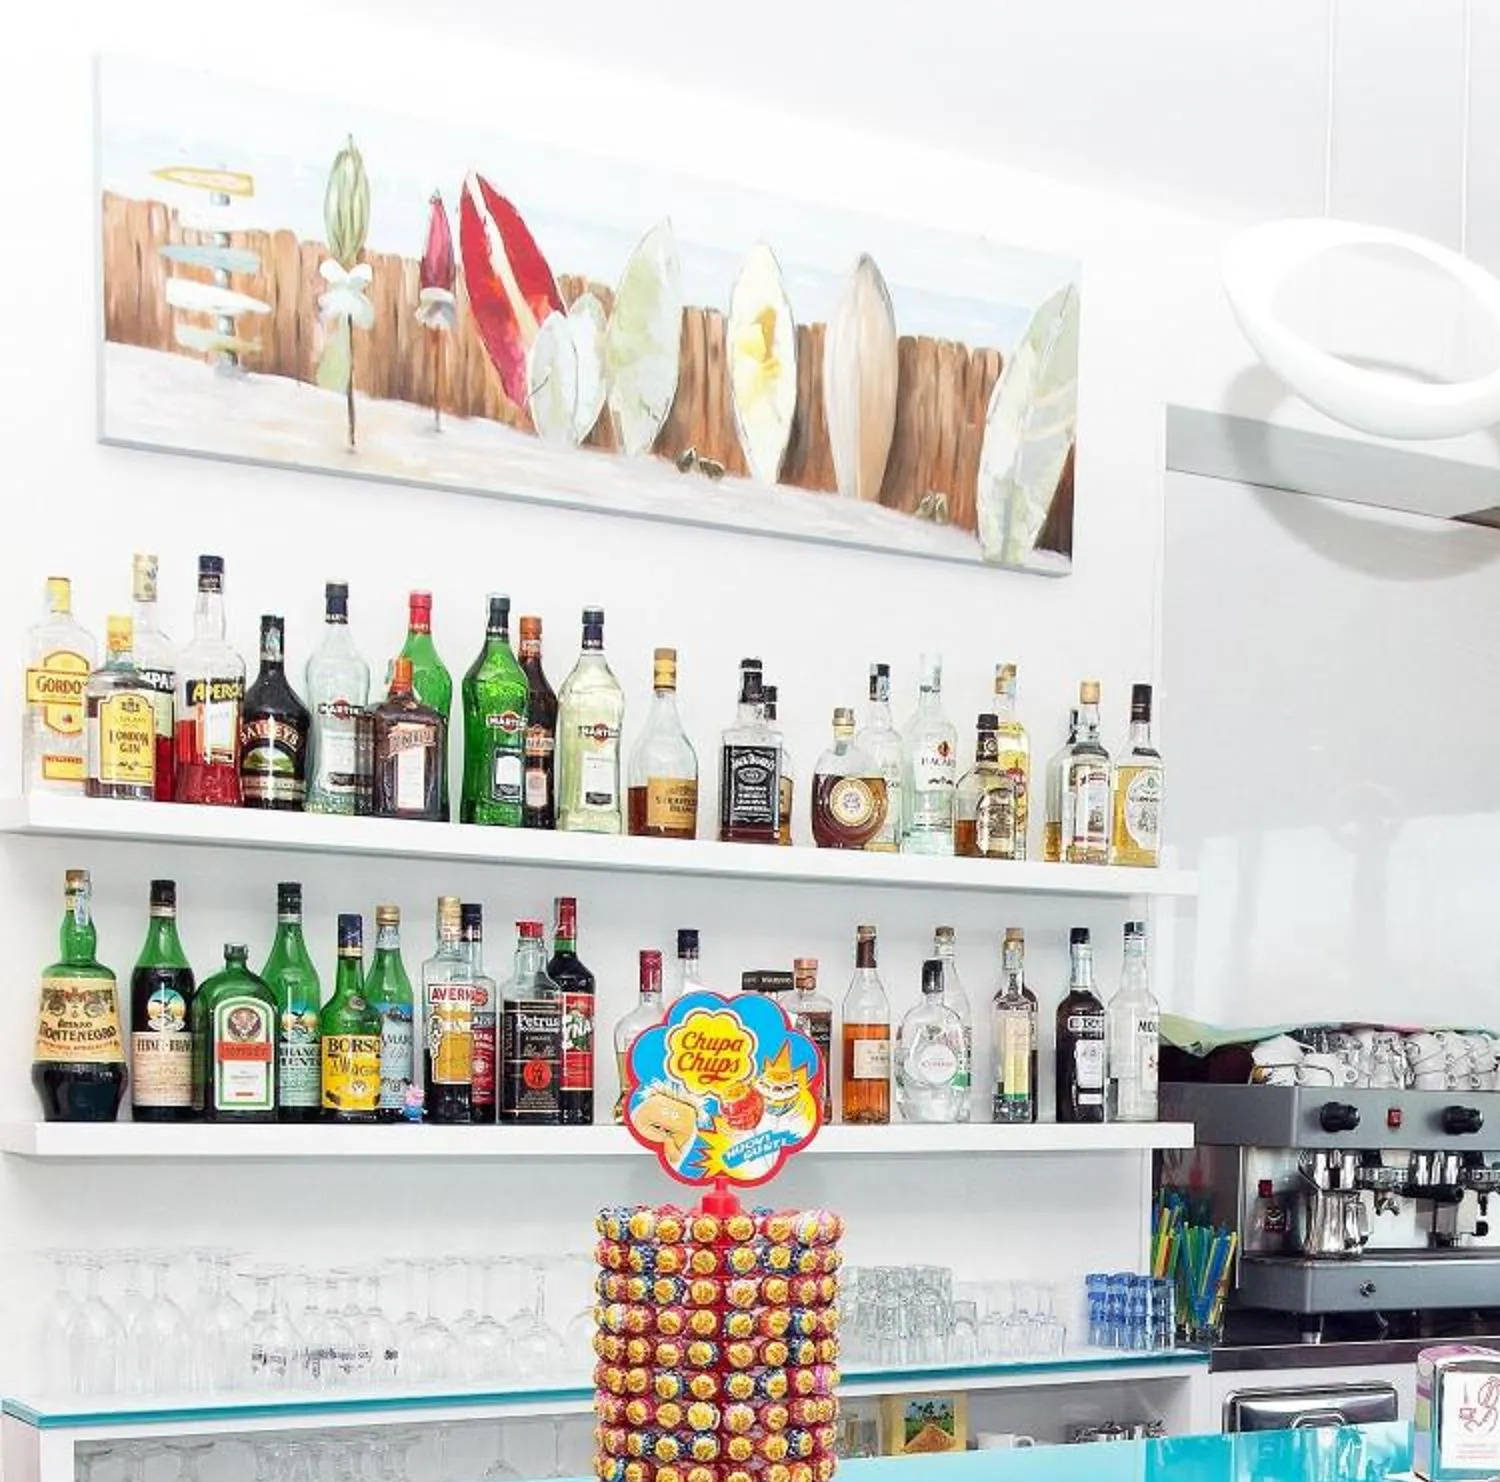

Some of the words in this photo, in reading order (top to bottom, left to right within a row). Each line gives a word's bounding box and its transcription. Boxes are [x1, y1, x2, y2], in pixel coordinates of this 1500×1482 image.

[36, 675, 88, 695] GORDO
[516, 1013, 560, 1028] Petrus
[681, 1031, 745, 1055] Chupa
[677, 1051, 741, 1076] Chups
